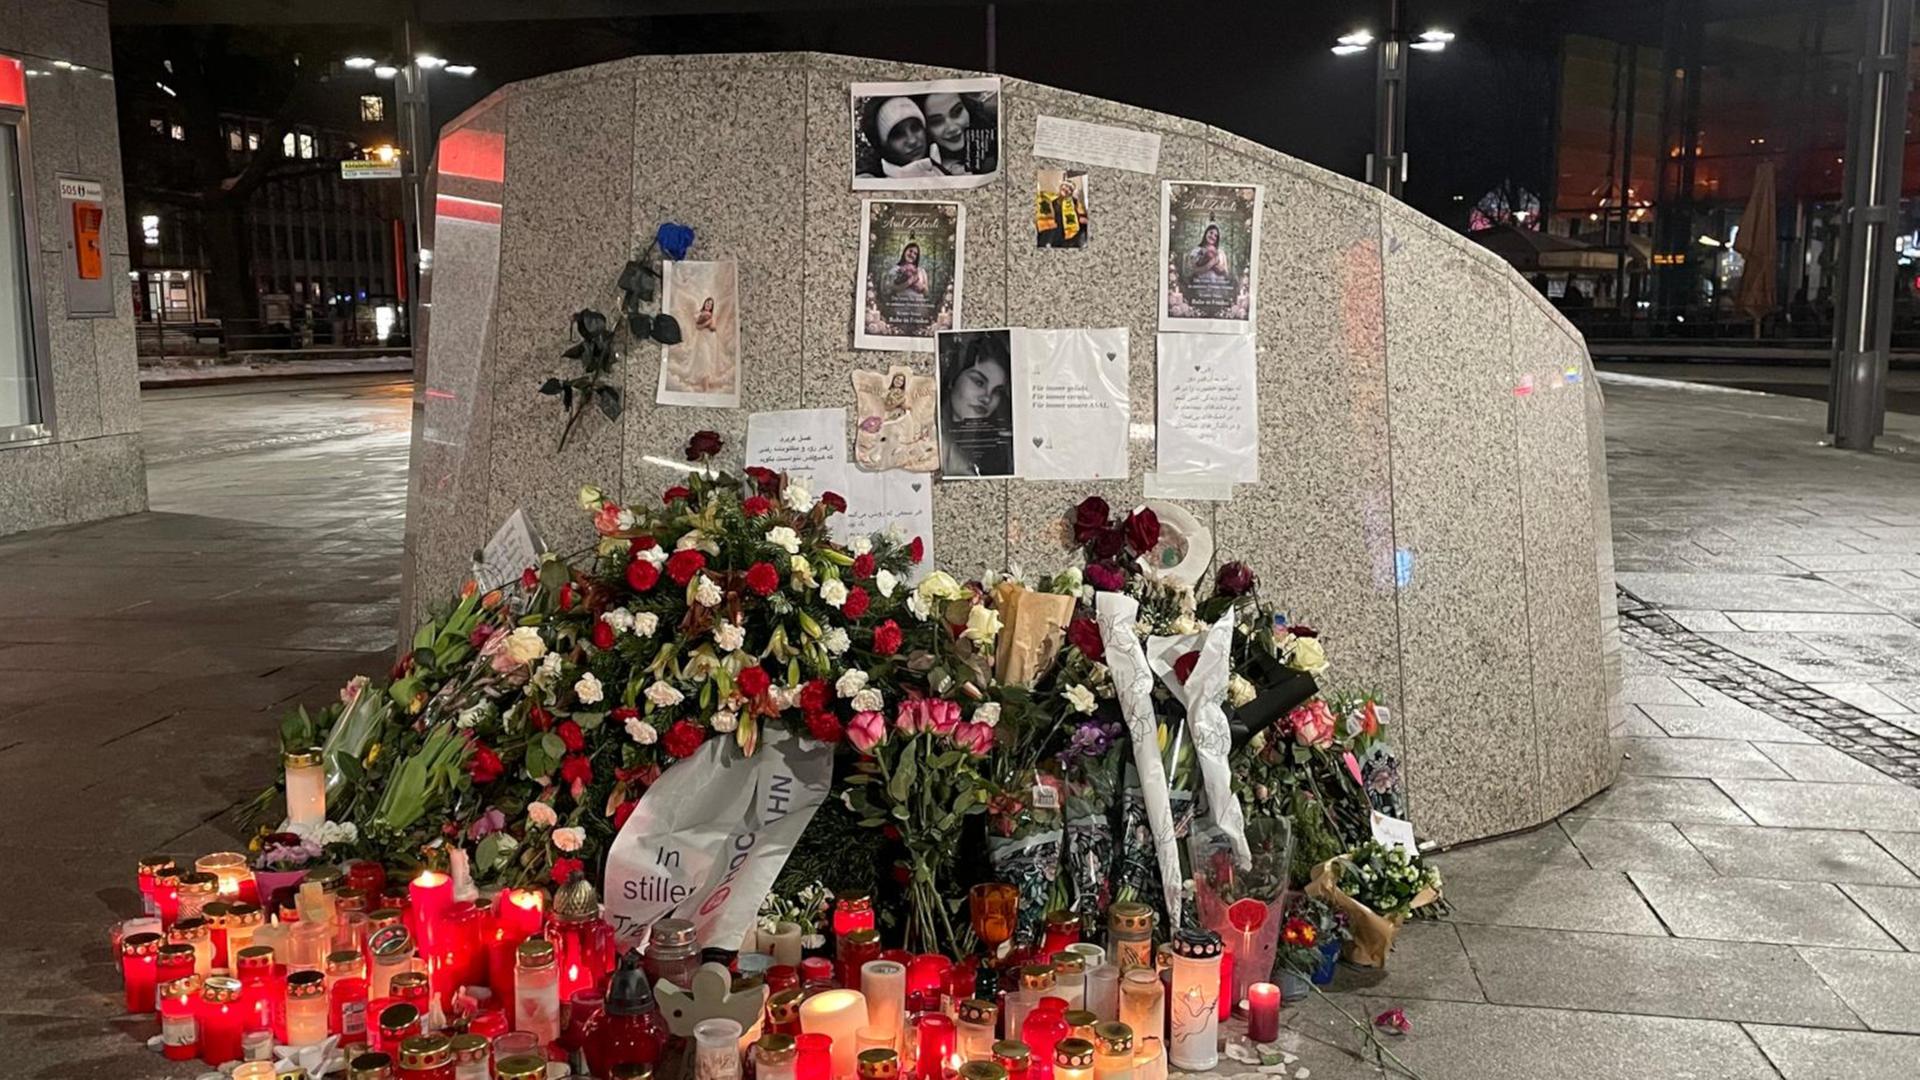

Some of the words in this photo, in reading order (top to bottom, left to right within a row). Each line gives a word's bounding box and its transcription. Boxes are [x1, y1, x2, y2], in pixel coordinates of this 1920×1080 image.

[61, 184, 76, 195] SOS
[656, 846, 680, 867] In
[613, 914, 648, 937] Tra
